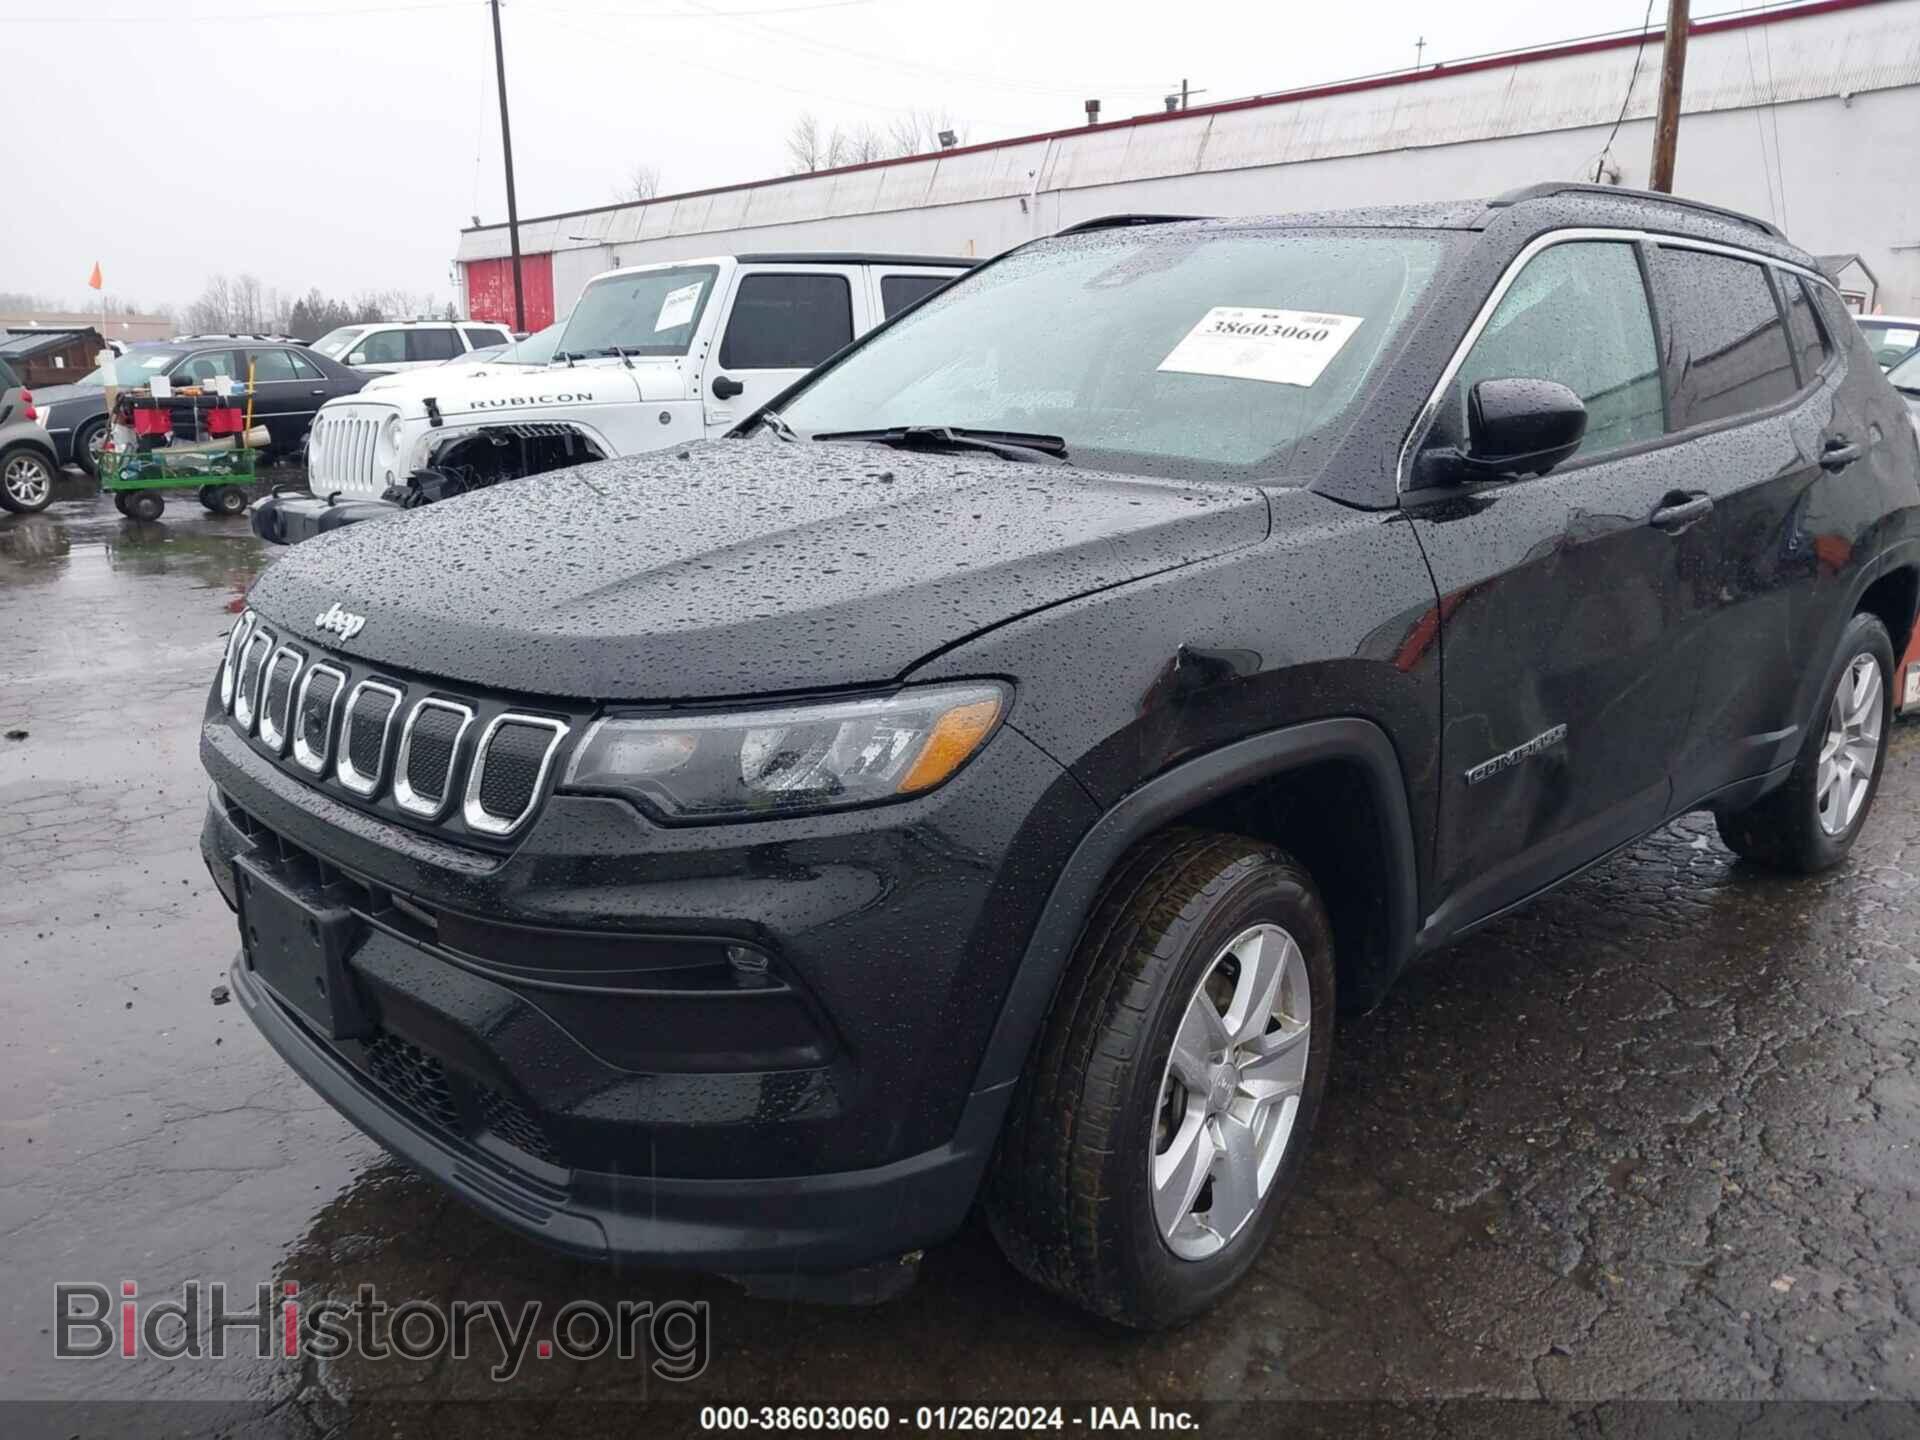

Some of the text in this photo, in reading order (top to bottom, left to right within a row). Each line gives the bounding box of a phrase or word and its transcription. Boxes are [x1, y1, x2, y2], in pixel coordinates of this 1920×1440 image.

[1205, 320, 1329, 342] 38603060
[470, 392, 593, 409] RUBICON
[315, 602, 366, 641] Jeep
